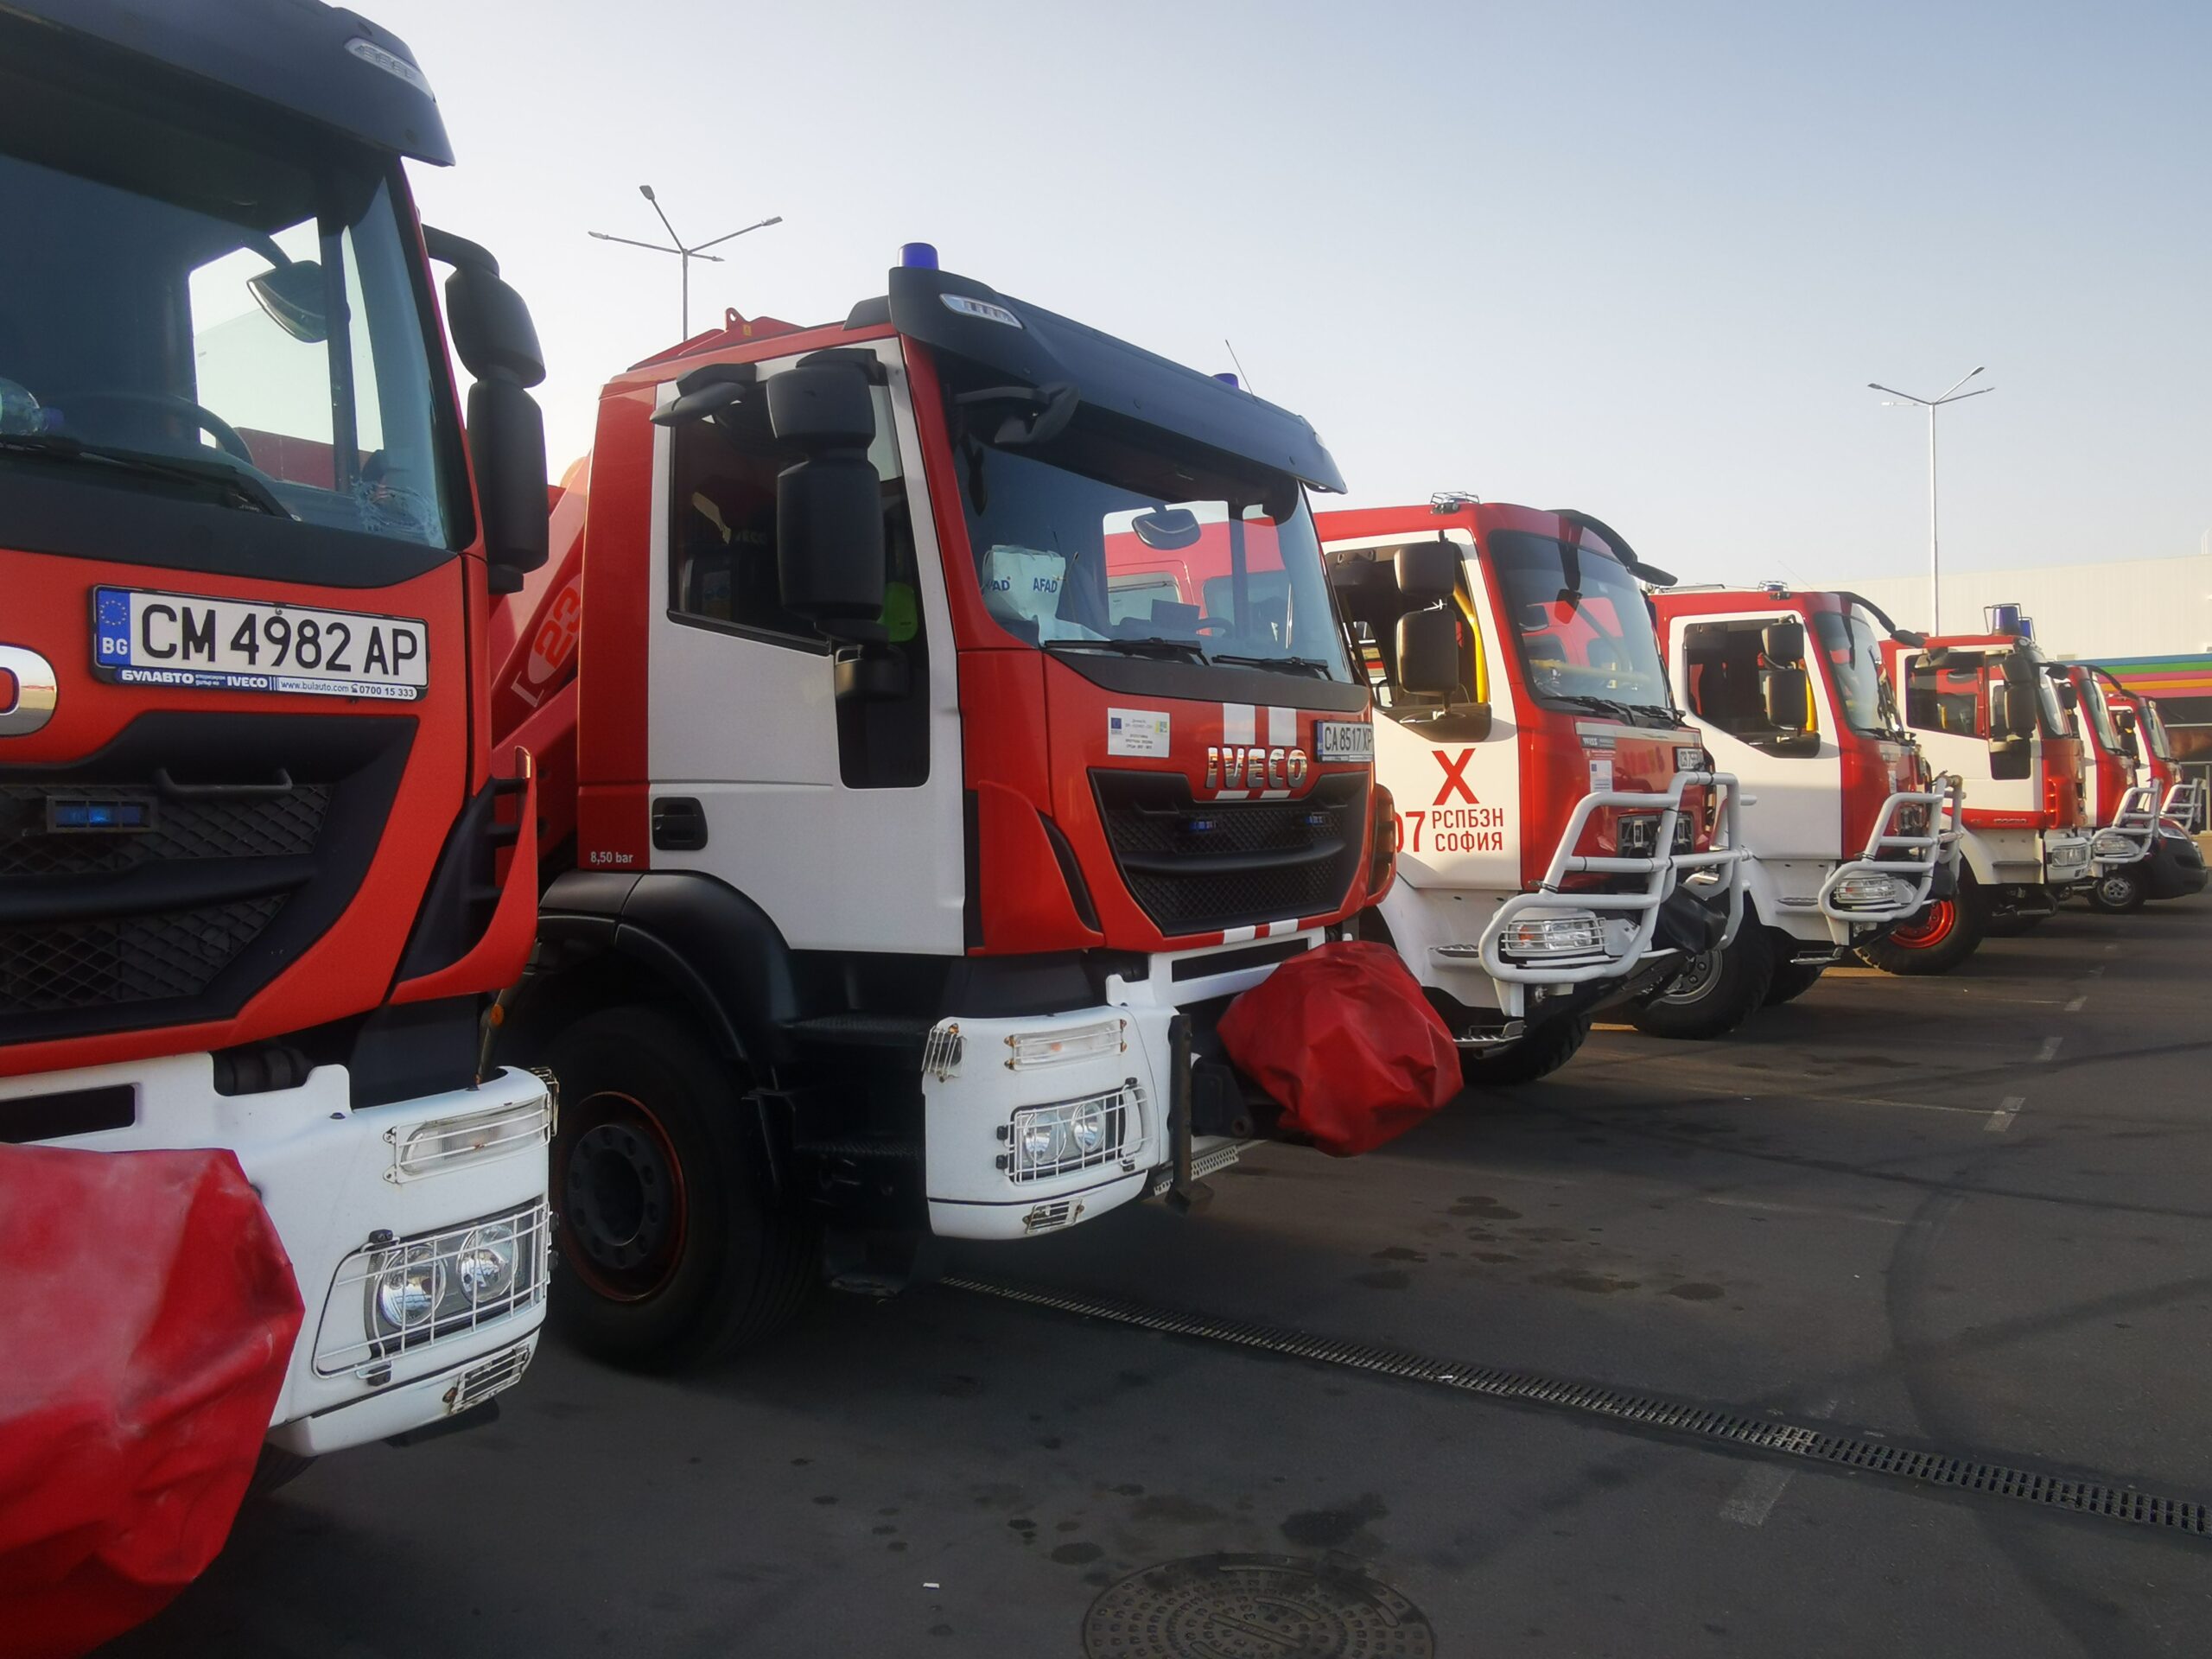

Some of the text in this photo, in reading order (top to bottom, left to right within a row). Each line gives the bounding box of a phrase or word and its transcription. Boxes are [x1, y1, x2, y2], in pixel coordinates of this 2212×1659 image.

[1033, 577, 1058, 593] AFAD
[102, 637, 128, 655] BG
[142, 604, 417, 676] CM 4982 AP
[122, 670, 194, 684] БУЛАВТО
[227, 676, 268, 688] IVECO
[281, 680, 349, 692] www.bulauto.com
[359, 685, 414, 697] 0700 15 333
[1325, 727, 1338, 751] CA
[1340, 727, 1362, 751] 8517
[1205, 747, 1308, 788] IVECO
[1432, 808, 1503, 830] РСПБЗН
[1435, 830, 1503, 853] СОФИЯ
[591, 851, 634, 866] 8,50 bar
